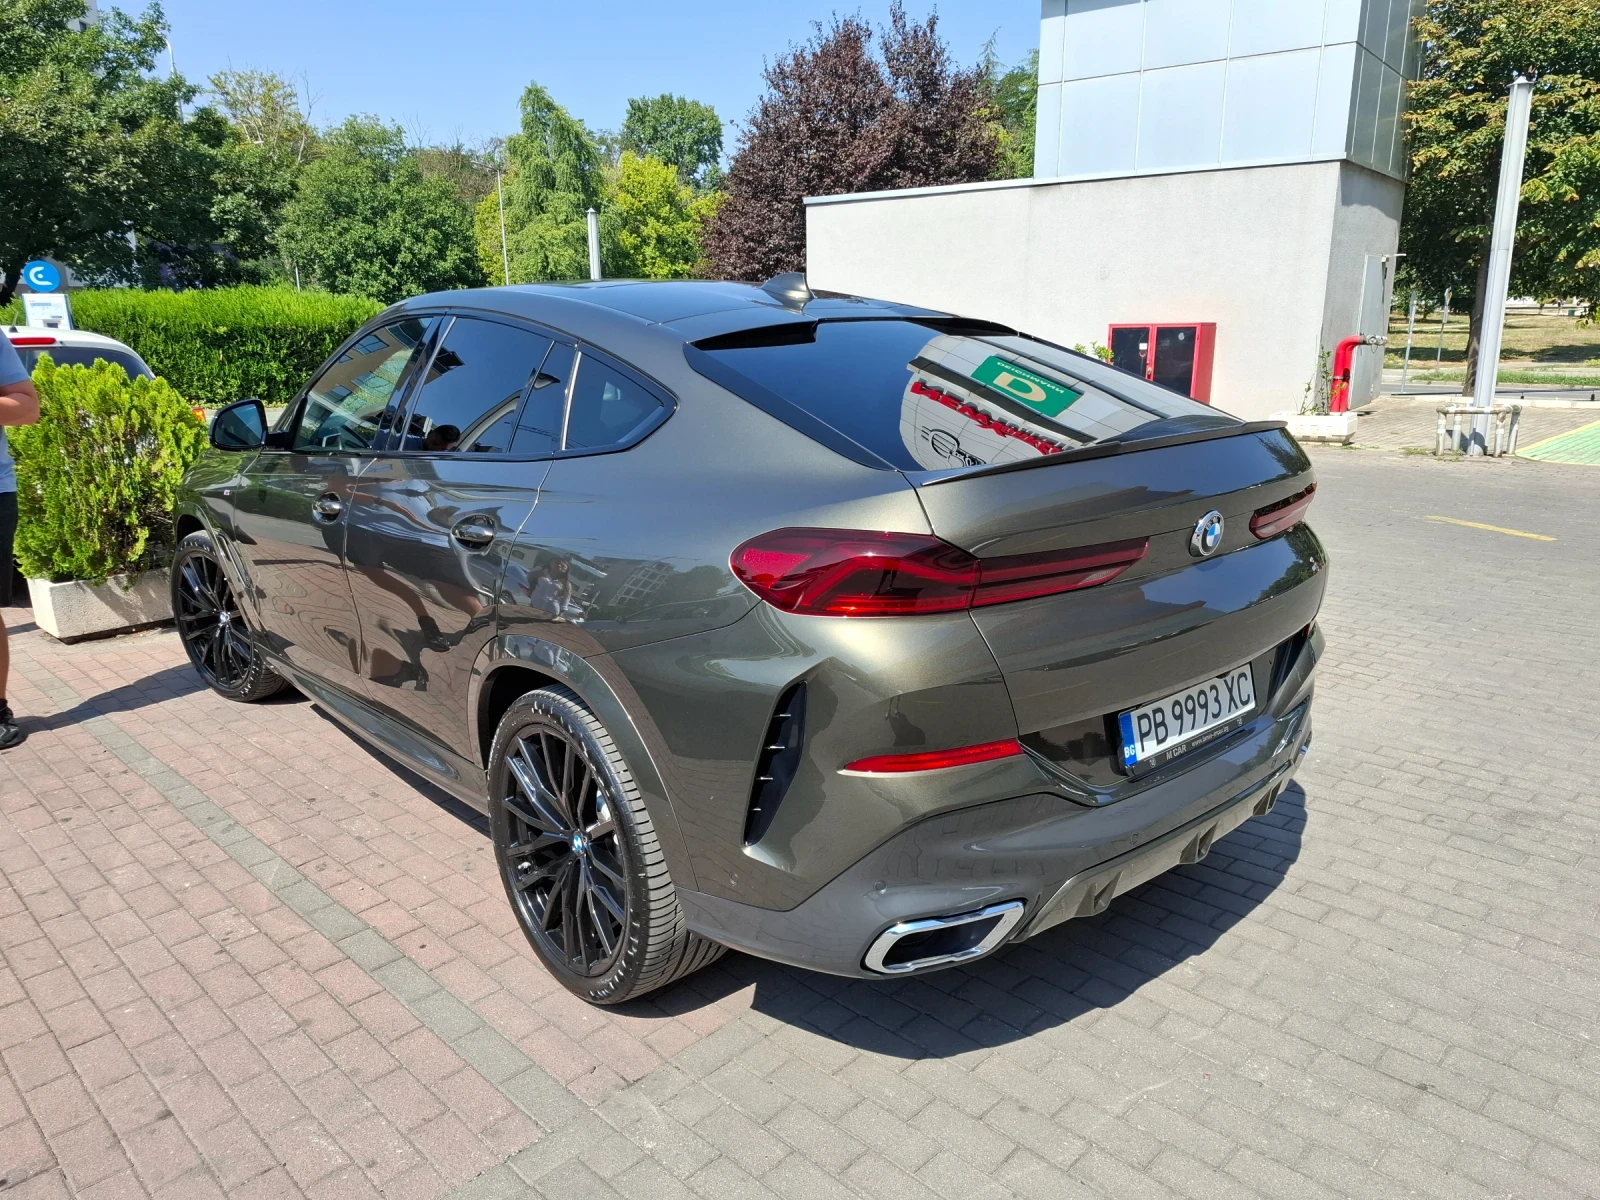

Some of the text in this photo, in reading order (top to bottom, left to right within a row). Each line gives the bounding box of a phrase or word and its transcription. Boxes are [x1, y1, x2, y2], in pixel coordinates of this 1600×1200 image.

[1137, 672, 1250, 752] PB 9993 XC
[1124, 746, 1136, 758] BG
